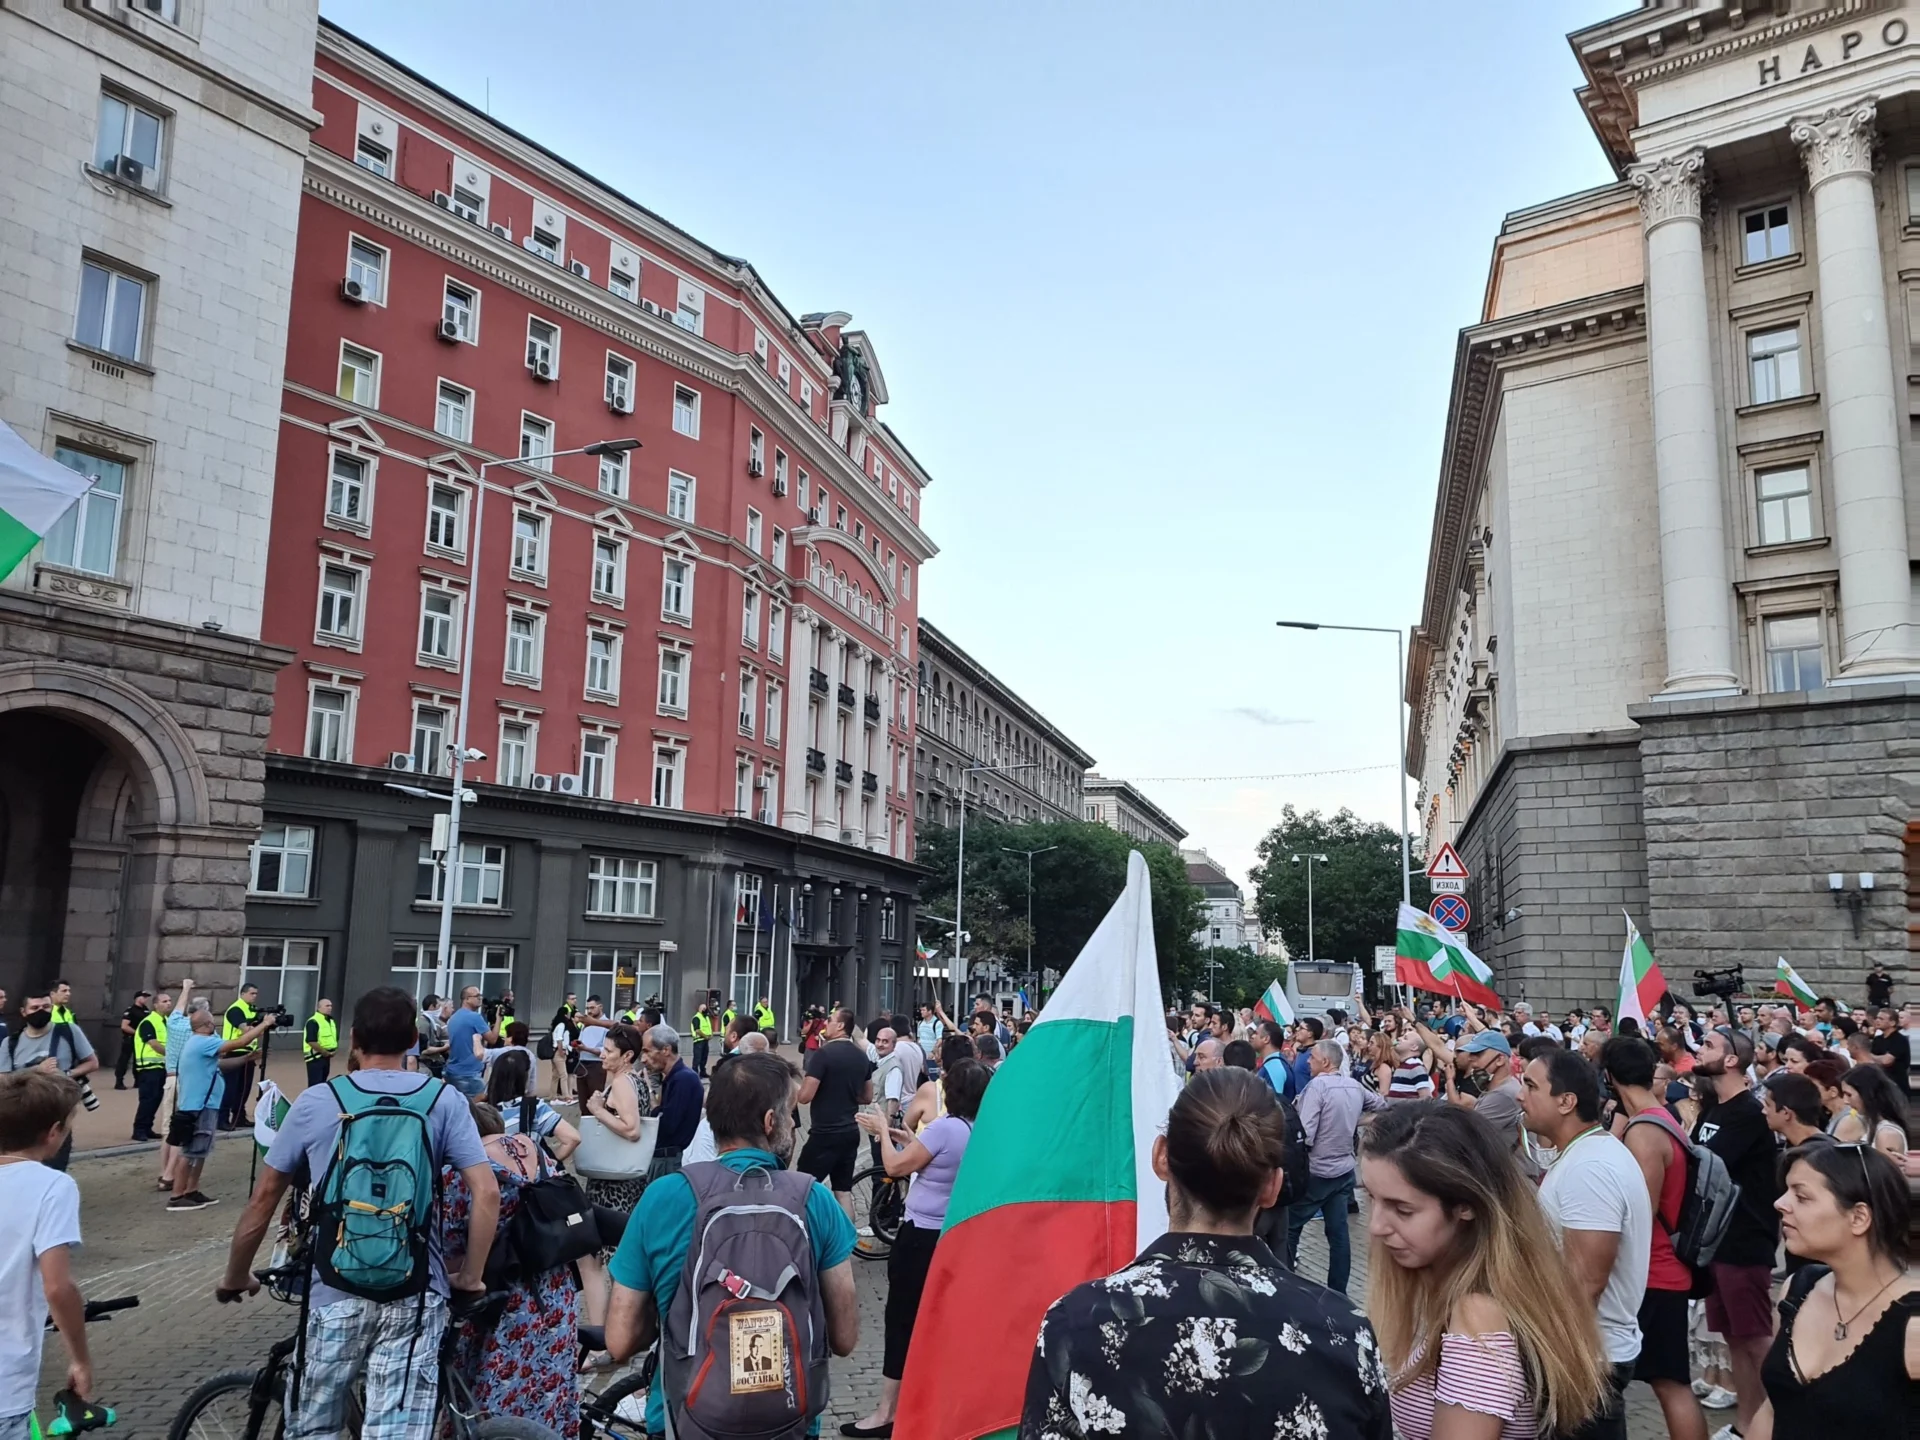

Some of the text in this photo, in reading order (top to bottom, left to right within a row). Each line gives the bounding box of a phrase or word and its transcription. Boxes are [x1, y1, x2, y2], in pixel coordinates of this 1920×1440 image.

[1758, 17, 1909, 85] НАРО
[1436, 881, 1460, 890] ИЗХОД
[736, 1316, 776, 1329] WANTED
[736, 1374, 780, 1385] #ОСТАВКА
[783, 1346, 796, 1408] DAKINE
